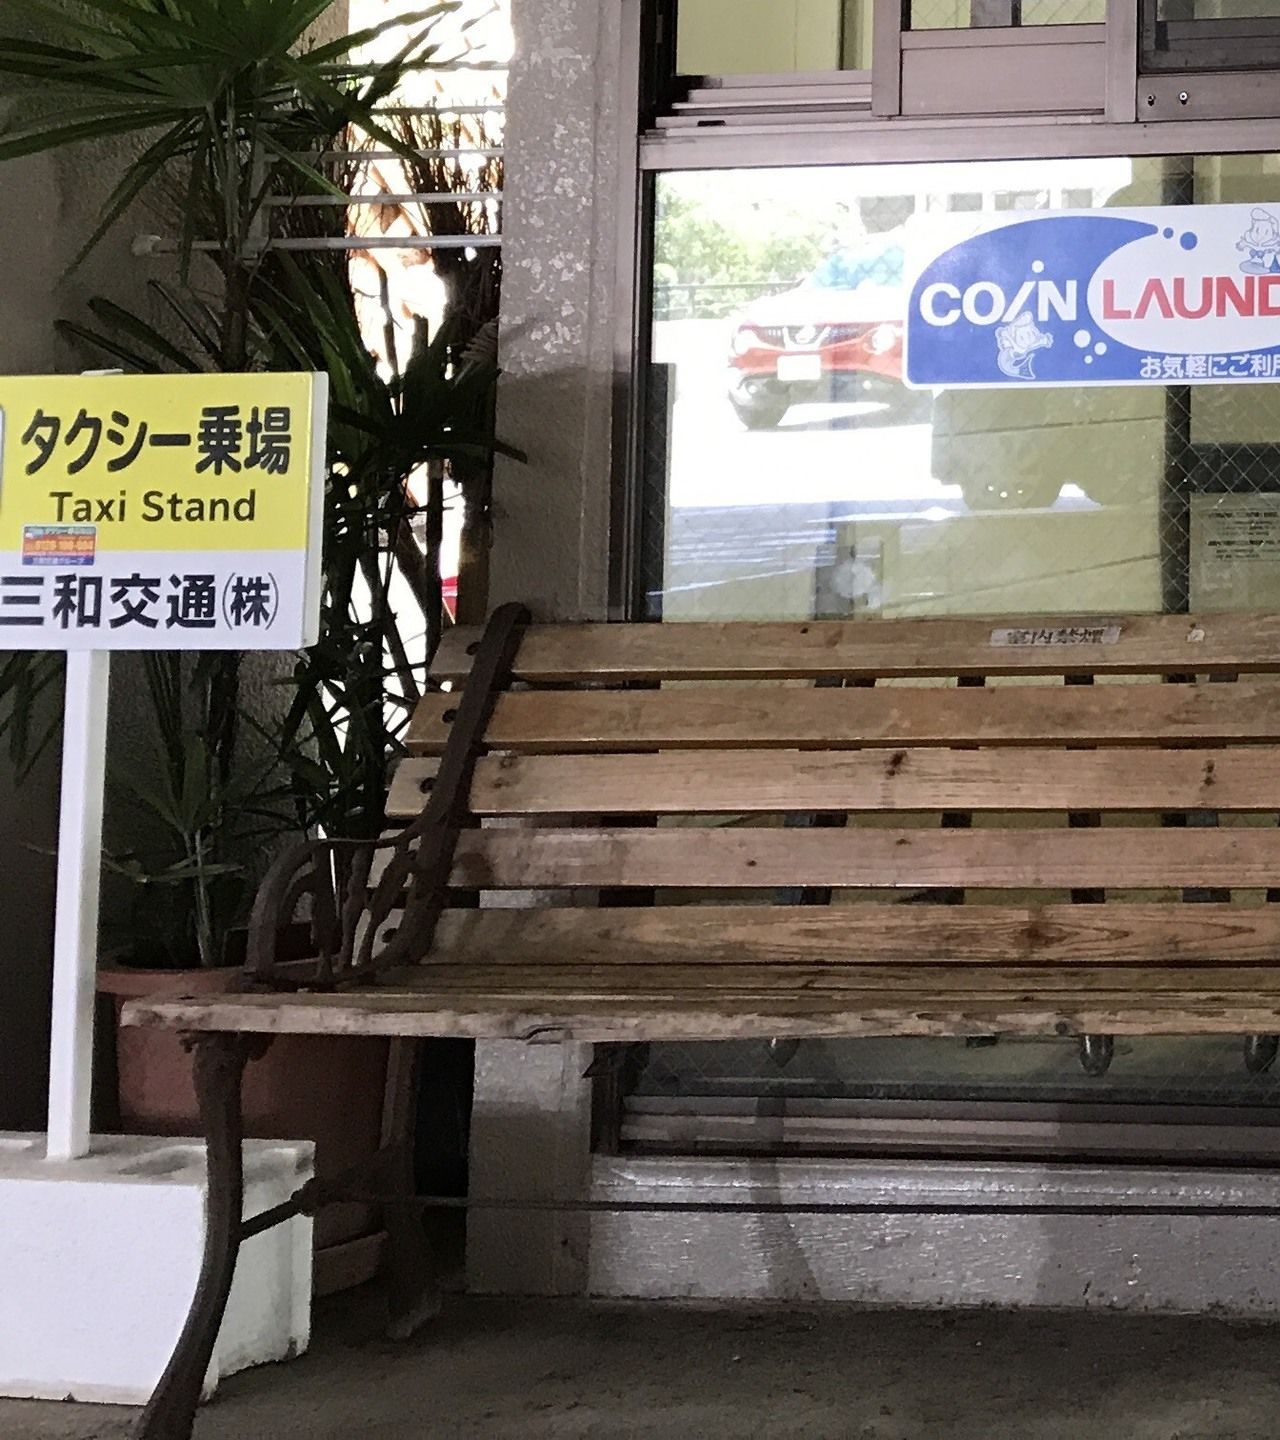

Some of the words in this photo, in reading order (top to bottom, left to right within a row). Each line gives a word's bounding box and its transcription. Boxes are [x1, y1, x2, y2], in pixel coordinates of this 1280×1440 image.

[920, 260, 1078, 326] COIN
[21, 405, 292, 476] タクシー乗場
[50, 490, 126, 522] Taxi
[142, 489, 256, 522] Stand
